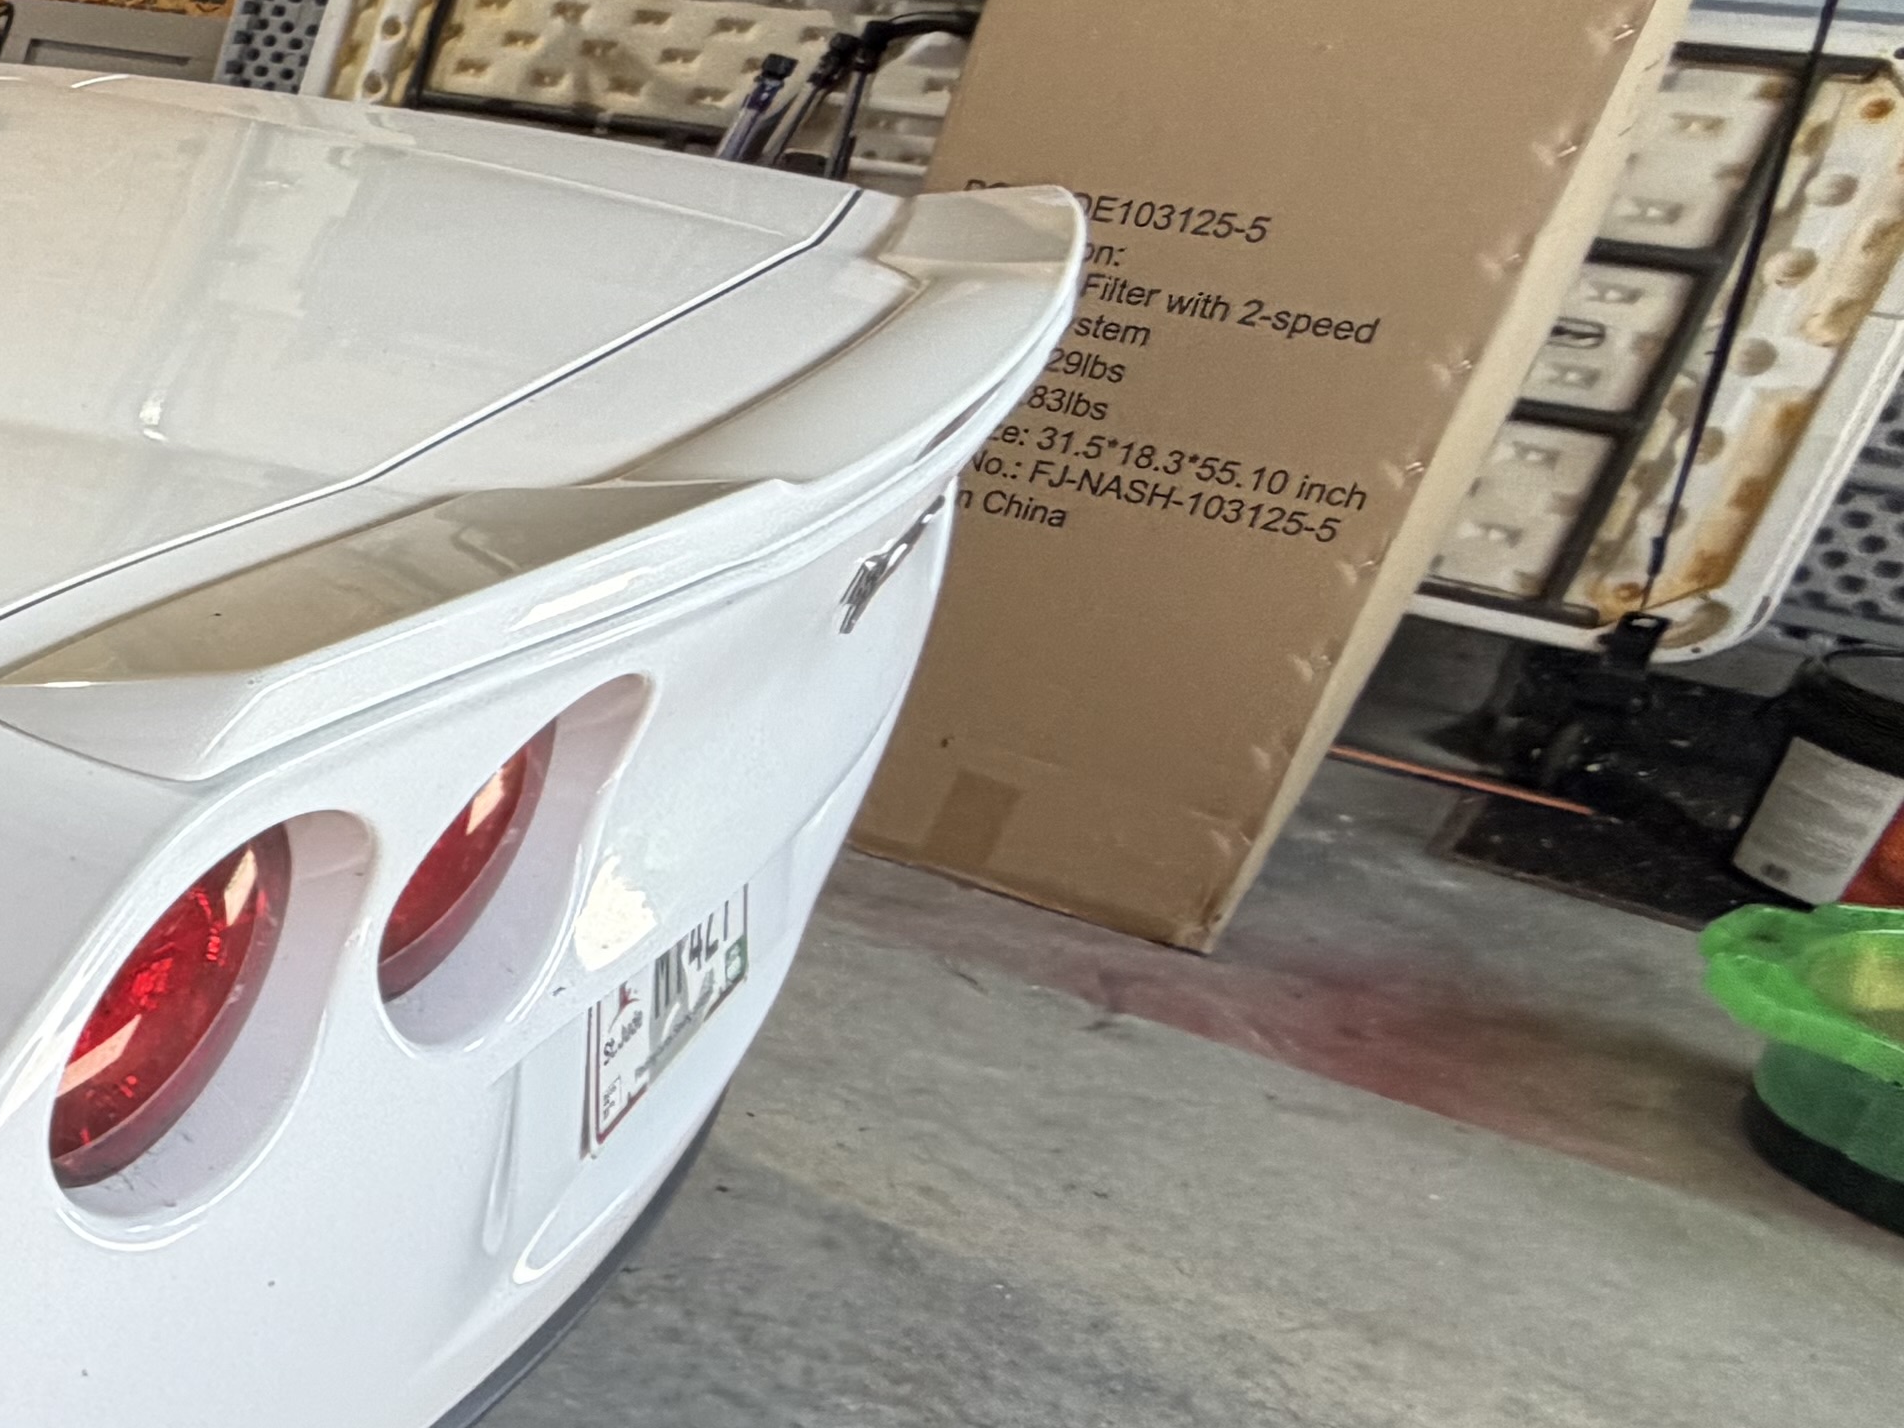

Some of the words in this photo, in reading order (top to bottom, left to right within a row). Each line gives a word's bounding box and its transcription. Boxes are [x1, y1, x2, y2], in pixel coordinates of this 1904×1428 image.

[1080, 273, 1162, 307] Filter
[1165, 289, 1232, 323] with
[1237, 298, 1382, 345] 2-speed
[1072, 314, 1151, 347] stem
[983, 489, 1068, 528] China
[1028, 459, 1343, 543] FJ-NASH-103125-5
[1296, 474, 1369, 511] inch
